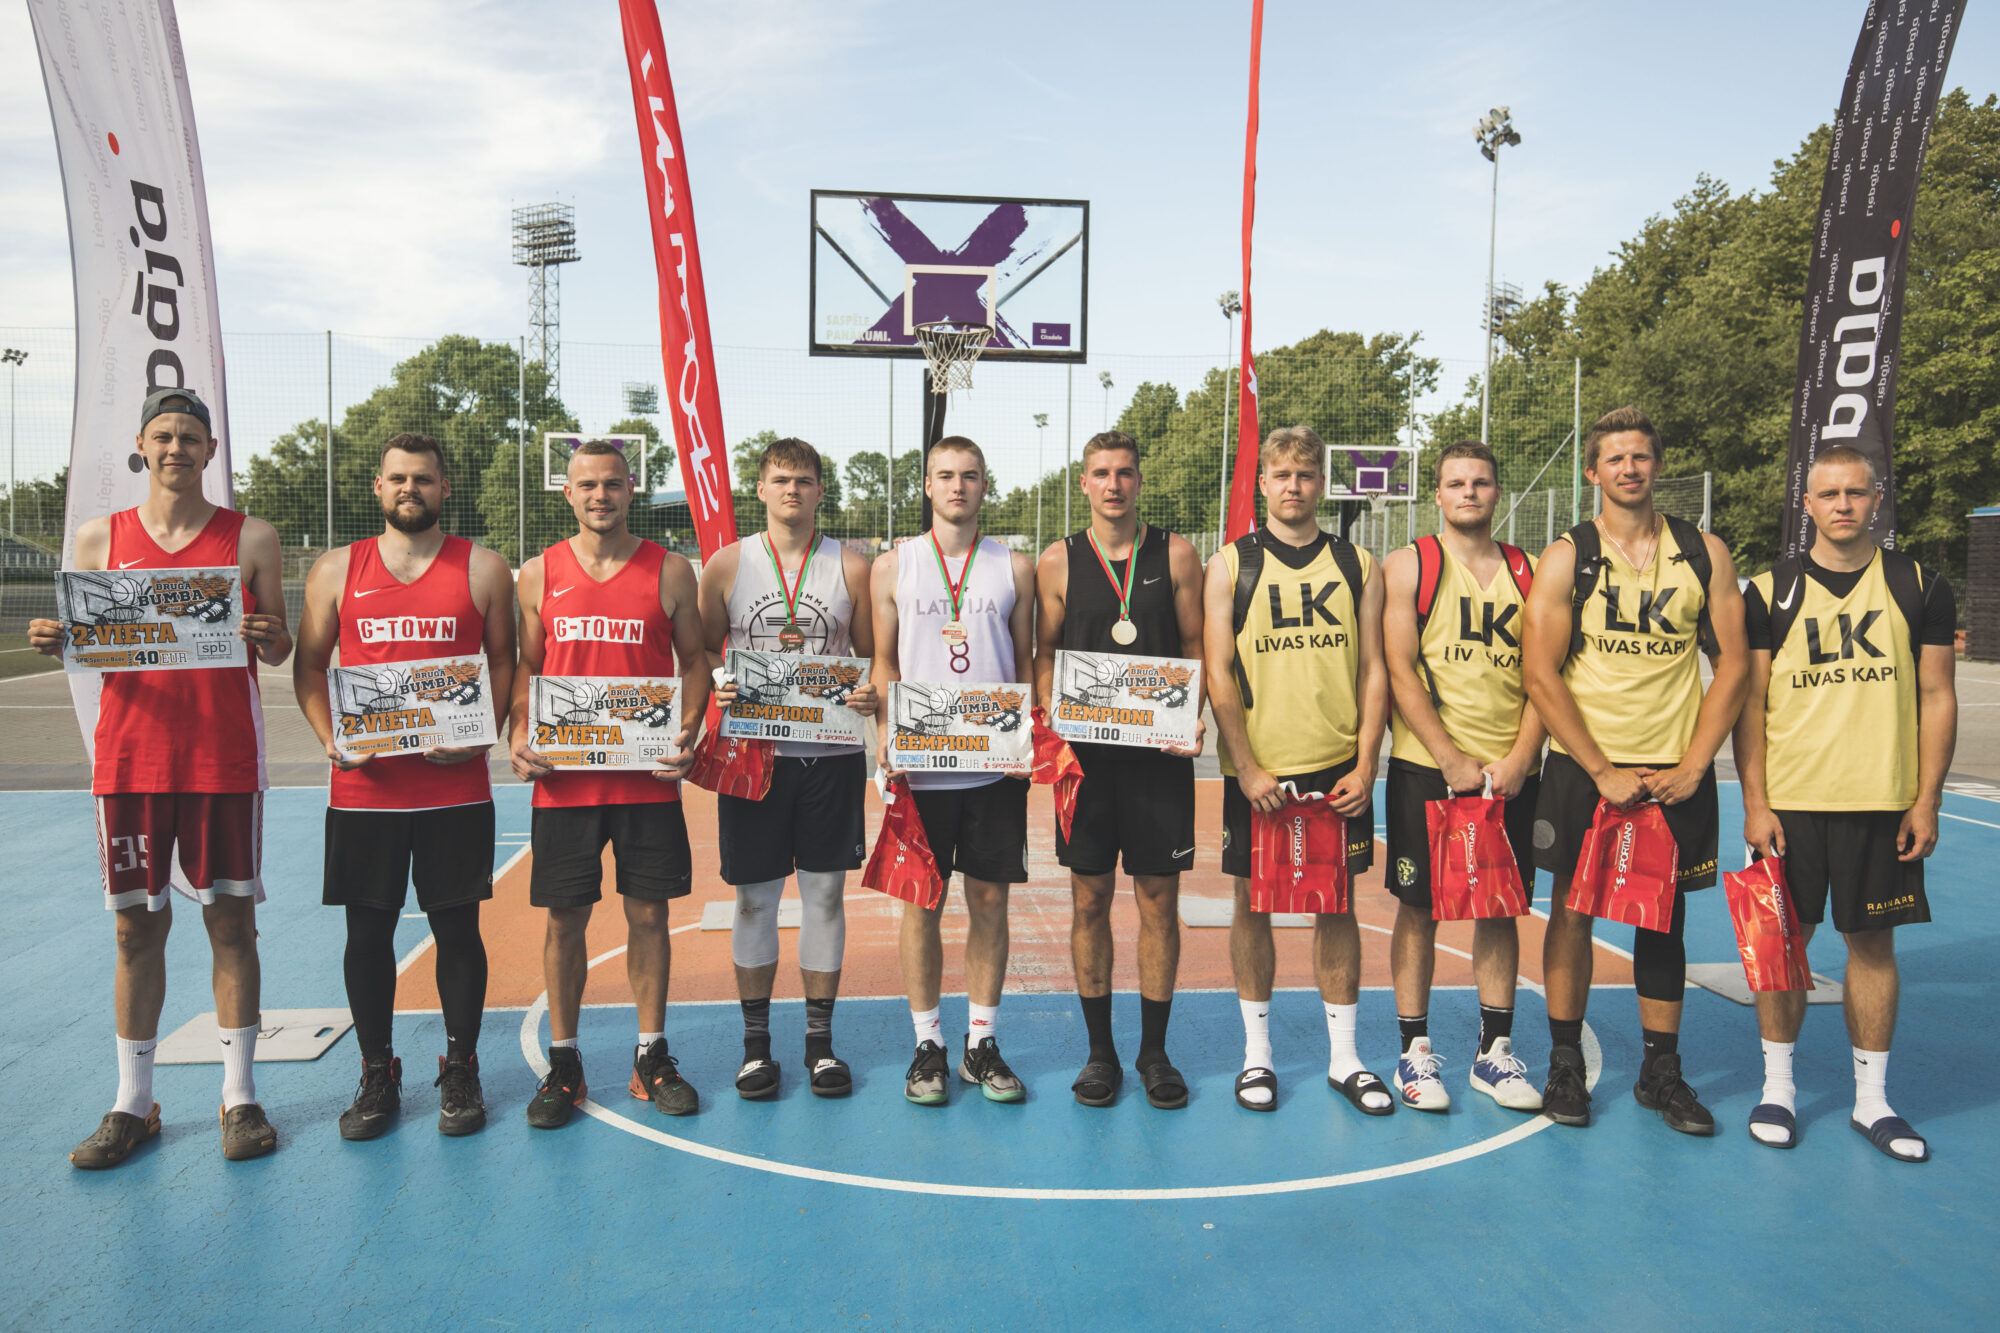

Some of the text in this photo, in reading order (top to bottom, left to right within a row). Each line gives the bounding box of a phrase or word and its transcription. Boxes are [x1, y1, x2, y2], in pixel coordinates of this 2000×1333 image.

[137, 589, 204, 606] BUMBA
[916, 598, 998, 615] LATIJA
[1268, 582, 1342, 629] LK
[1605, 585, 1679, 634] LK
[361, 619, 454, 639] G-TOWN
[556, 618, 641, 642] G-TOWN
[1460, 597, 1519, 647] LK
[72, 622, 178, 646] 2.VIETA
[1256, 633, 1348, 653] LĪVAS KAPI
[1805, 610, 1887, 665] LK
[202, 643, 227, 655] spb
[1594, 635, 1641, 654] ĪVAS
[135, 650, 159, 665] 40
[160, 652, 188, 664] EUR
[400, 676, 457, 695] BUMBA
[786, 674, 838, 686] BUMBA
[1115, 676, 1168, 687] BUMBA
[1792, 667, 1898, 689] LĪVAS KAPI
[594, 696, 650, 710] BUMBA
[949, 702, 1001, 715] BUMBA
[342, 707, 436, 735] 2.VIETA
[1059, 700, 1154, 726] ČEMPIONI
[457, 723, 479, 735] spb
[536, 725, 624, 745] 2.VIETA
[765, 724, 791, 738] 100
[792, 729, 812, 739] EUR
[1094, 726, 1120, 741] 100
[1122, 732, 1142, 743] EUR
[398, 734, 420, 749] 40
[421, 734, 445, 746] EUR
[895, 730, 990, 751] ČEMPIONI
[586, 751, 606, 765] 40
[608, 754, 630, 764] EUR
[643, 746, 664, 757] spb
[932, 755, 957, 768] 100
[960, 759, 980, 768] EUR
[1294, 816, 1302, 867] SPORTLAND
[1619, 821, 1633, 873] SPORTLAND
[1867, 894, 1915, 911] RAINARS
